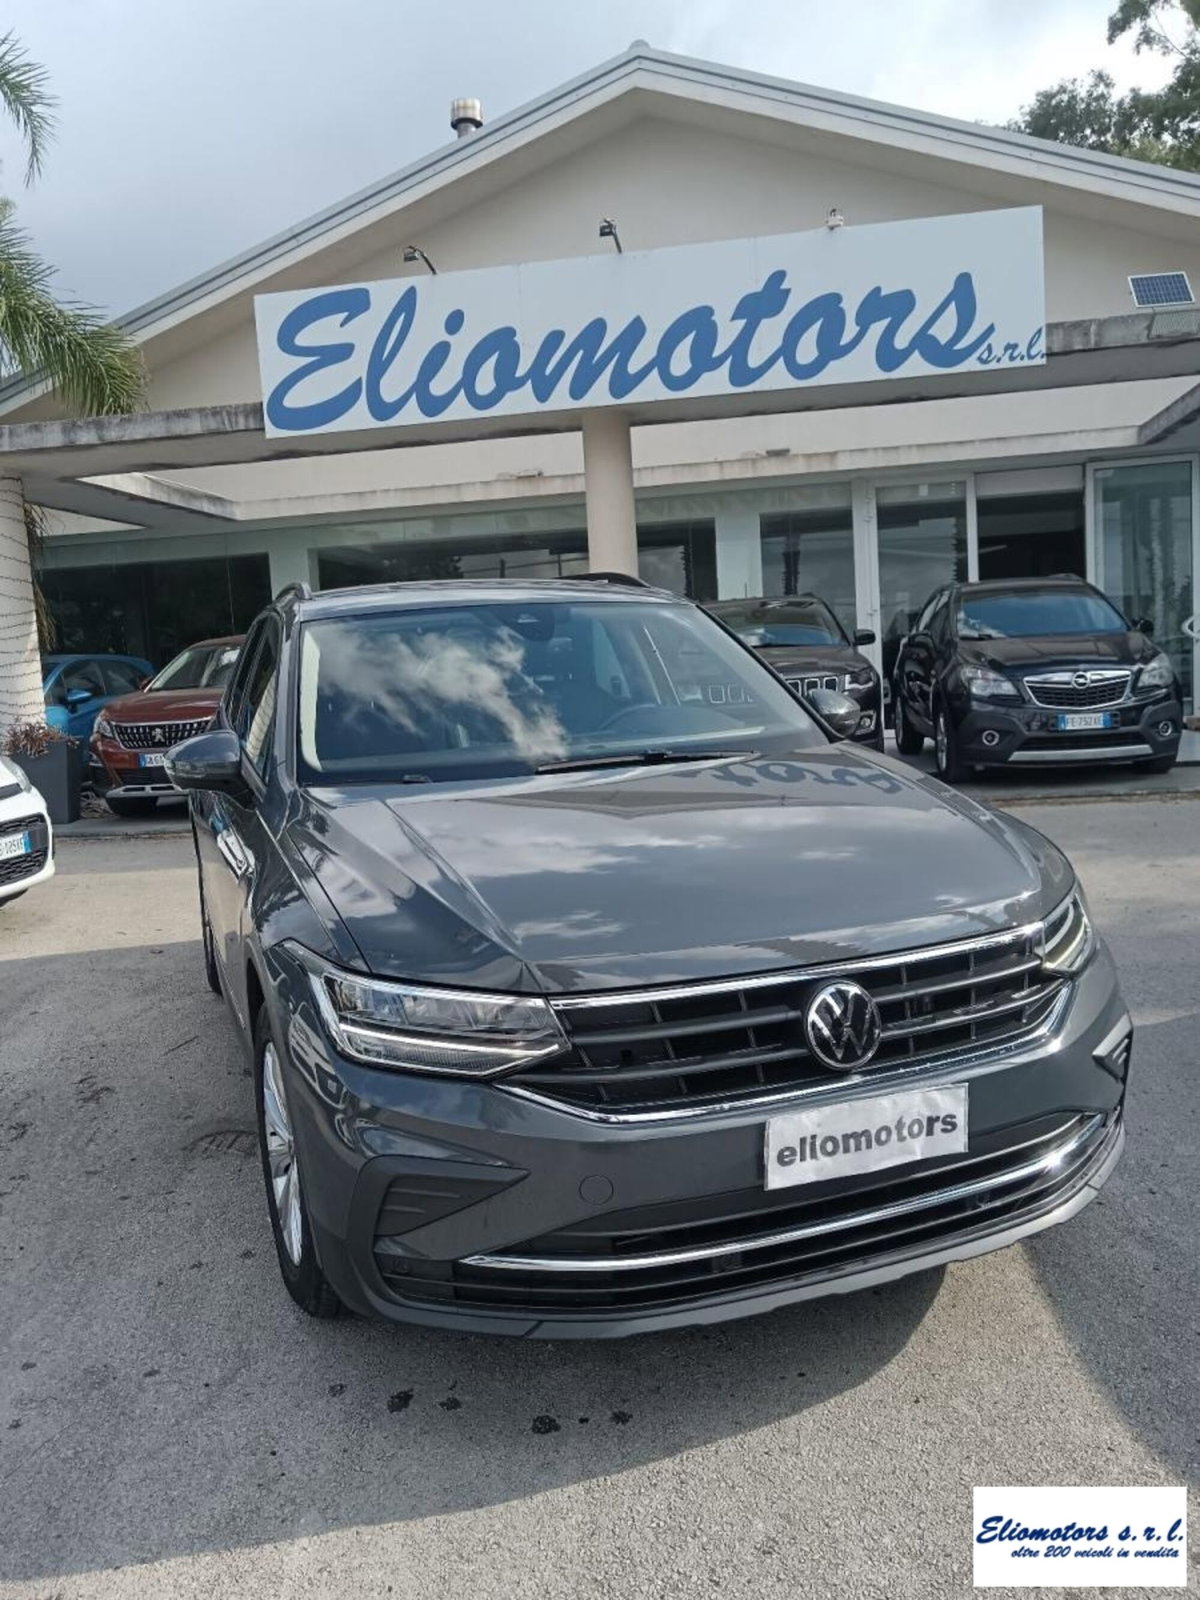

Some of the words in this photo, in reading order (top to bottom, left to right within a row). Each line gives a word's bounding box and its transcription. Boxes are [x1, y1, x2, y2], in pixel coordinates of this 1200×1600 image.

[265, 269, 997, 431] Eliomotors
[976, 326, 1046, 365] s.r.l.
[776, 1113, 958, 1167] eliomotors
